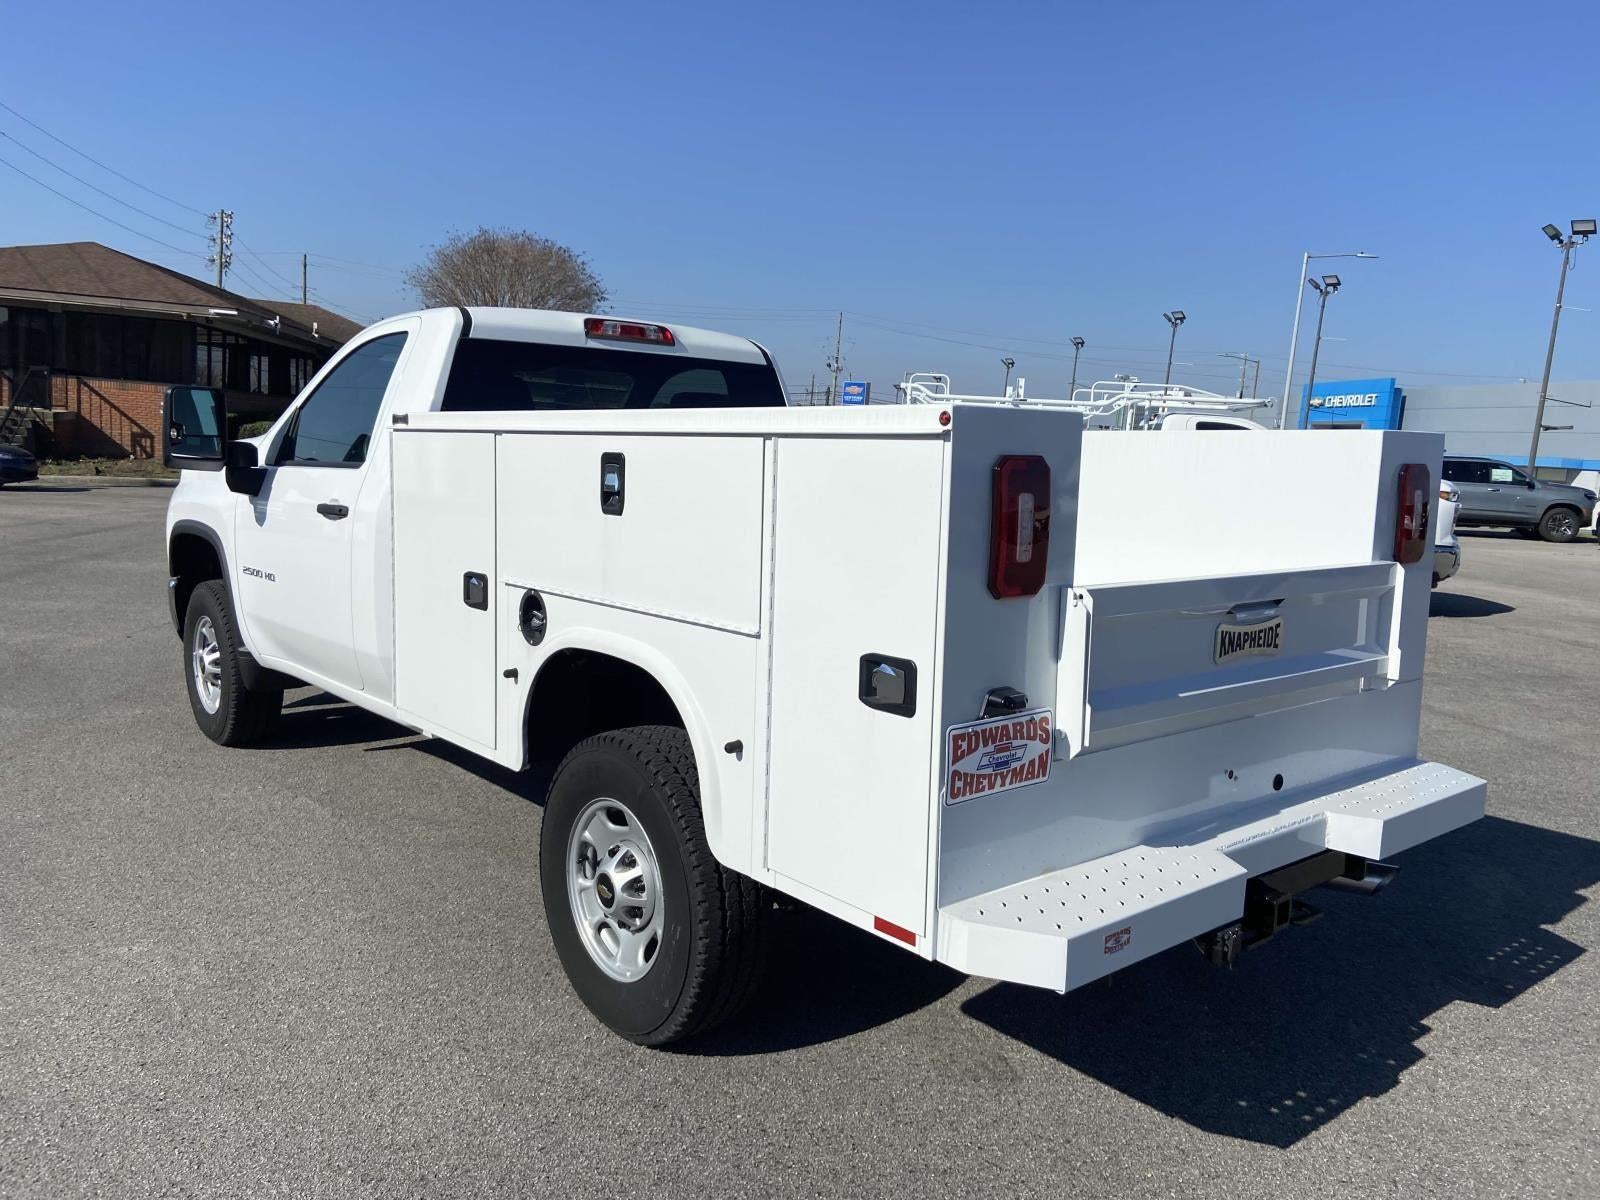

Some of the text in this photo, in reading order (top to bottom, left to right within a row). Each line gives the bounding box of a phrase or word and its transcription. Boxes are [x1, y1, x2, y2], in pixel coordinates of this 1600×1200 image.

[1325, 393, 1378, 408] CHEVROLET
[242, 566, 276, 582] 2500 HD
[1219, 622, 1281, 658] KNAPHEIDE
[952, 716, 1050, 766] EDWARDS
[988, 751, 1017, 763] Chevrolet
[949, 748, 1050, 800] CHEVYMAN
